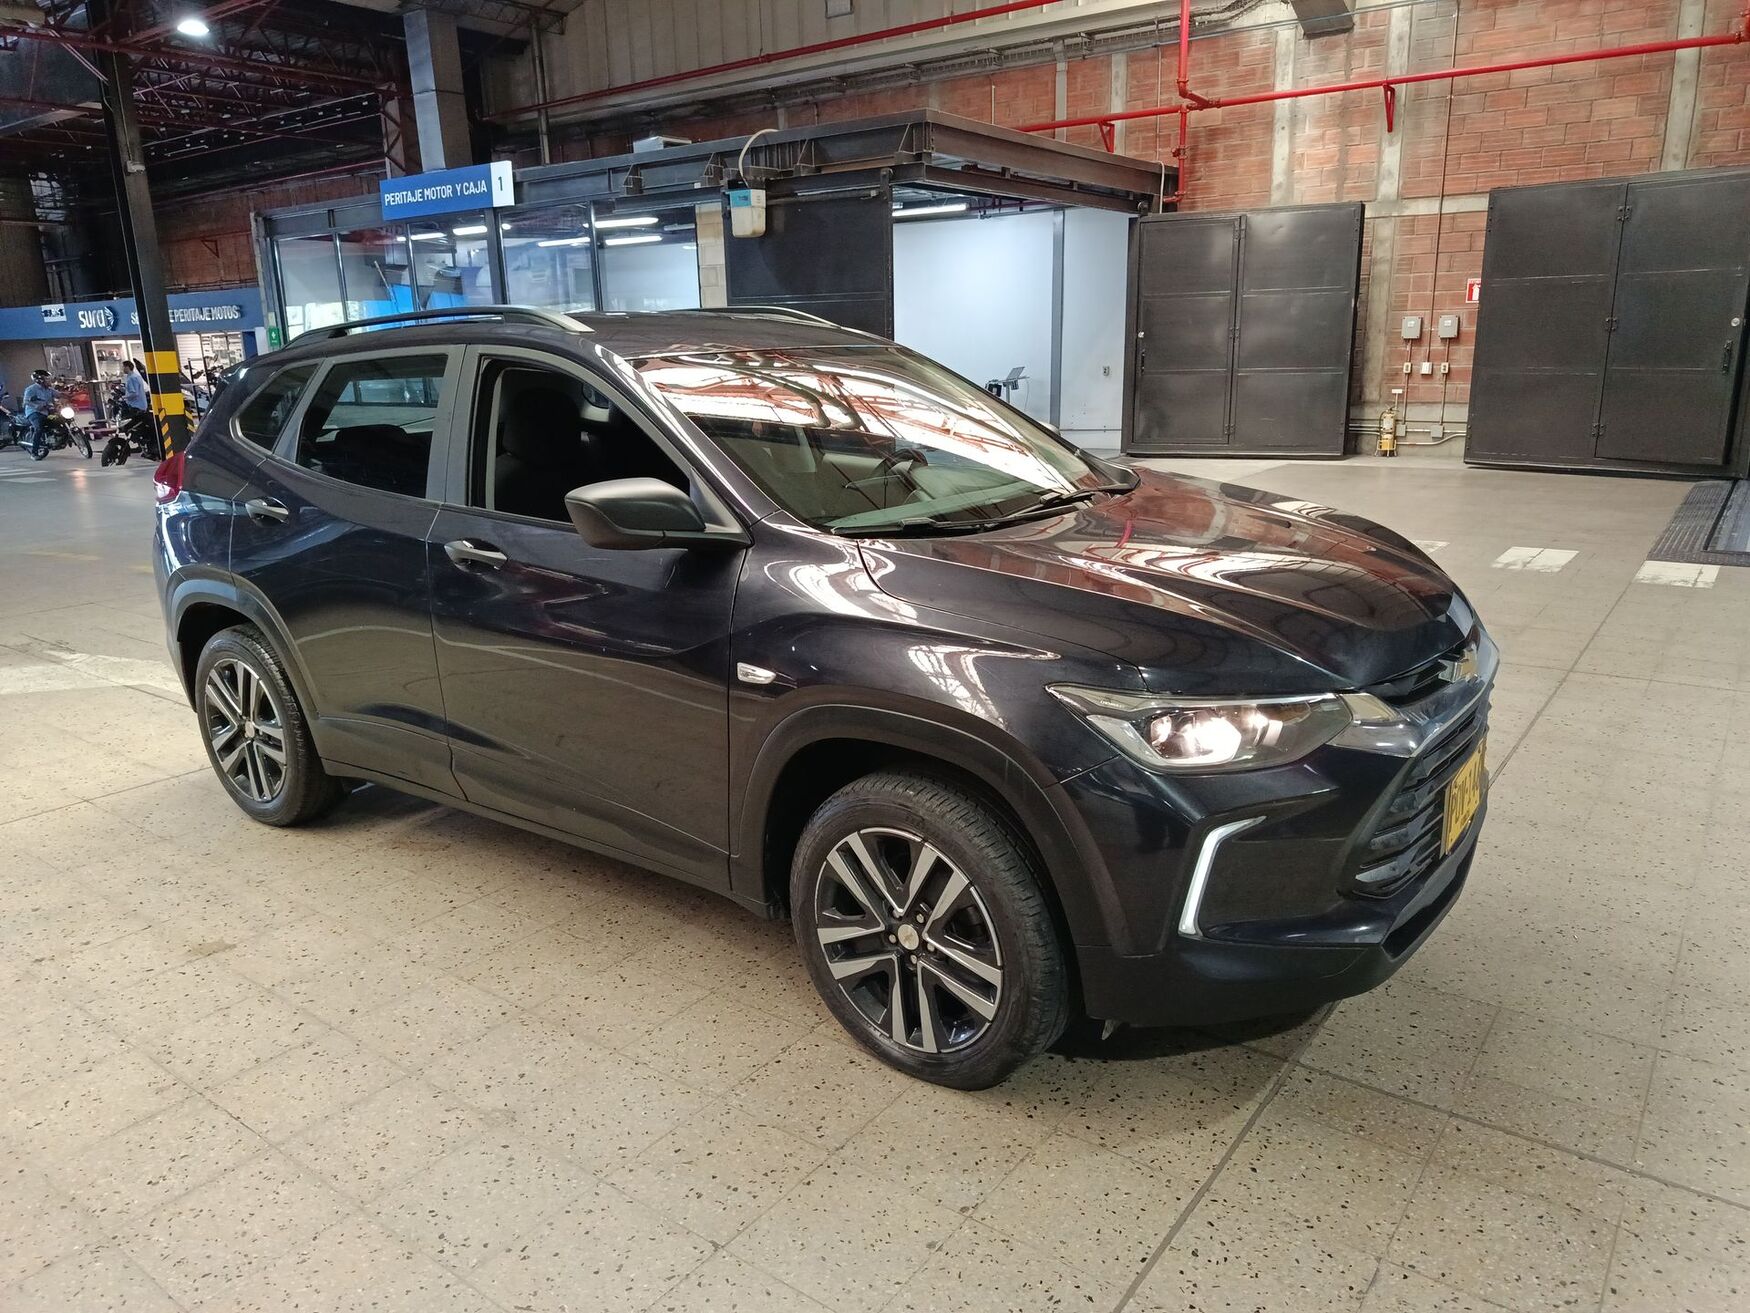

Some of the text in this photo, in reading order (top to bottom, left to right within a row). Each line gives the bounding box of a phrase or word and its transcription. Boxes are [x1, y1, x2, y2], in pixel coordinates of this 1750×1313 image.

[384, 179, 488, 206] PERITAJE MOTOR Y CAJA
[497, 176, 504, 191] 1
[78, 309, 106, 329] sura
[174, 306, 211, 323] PERITAJE
[211, 305, 239, 321] MOTOS
